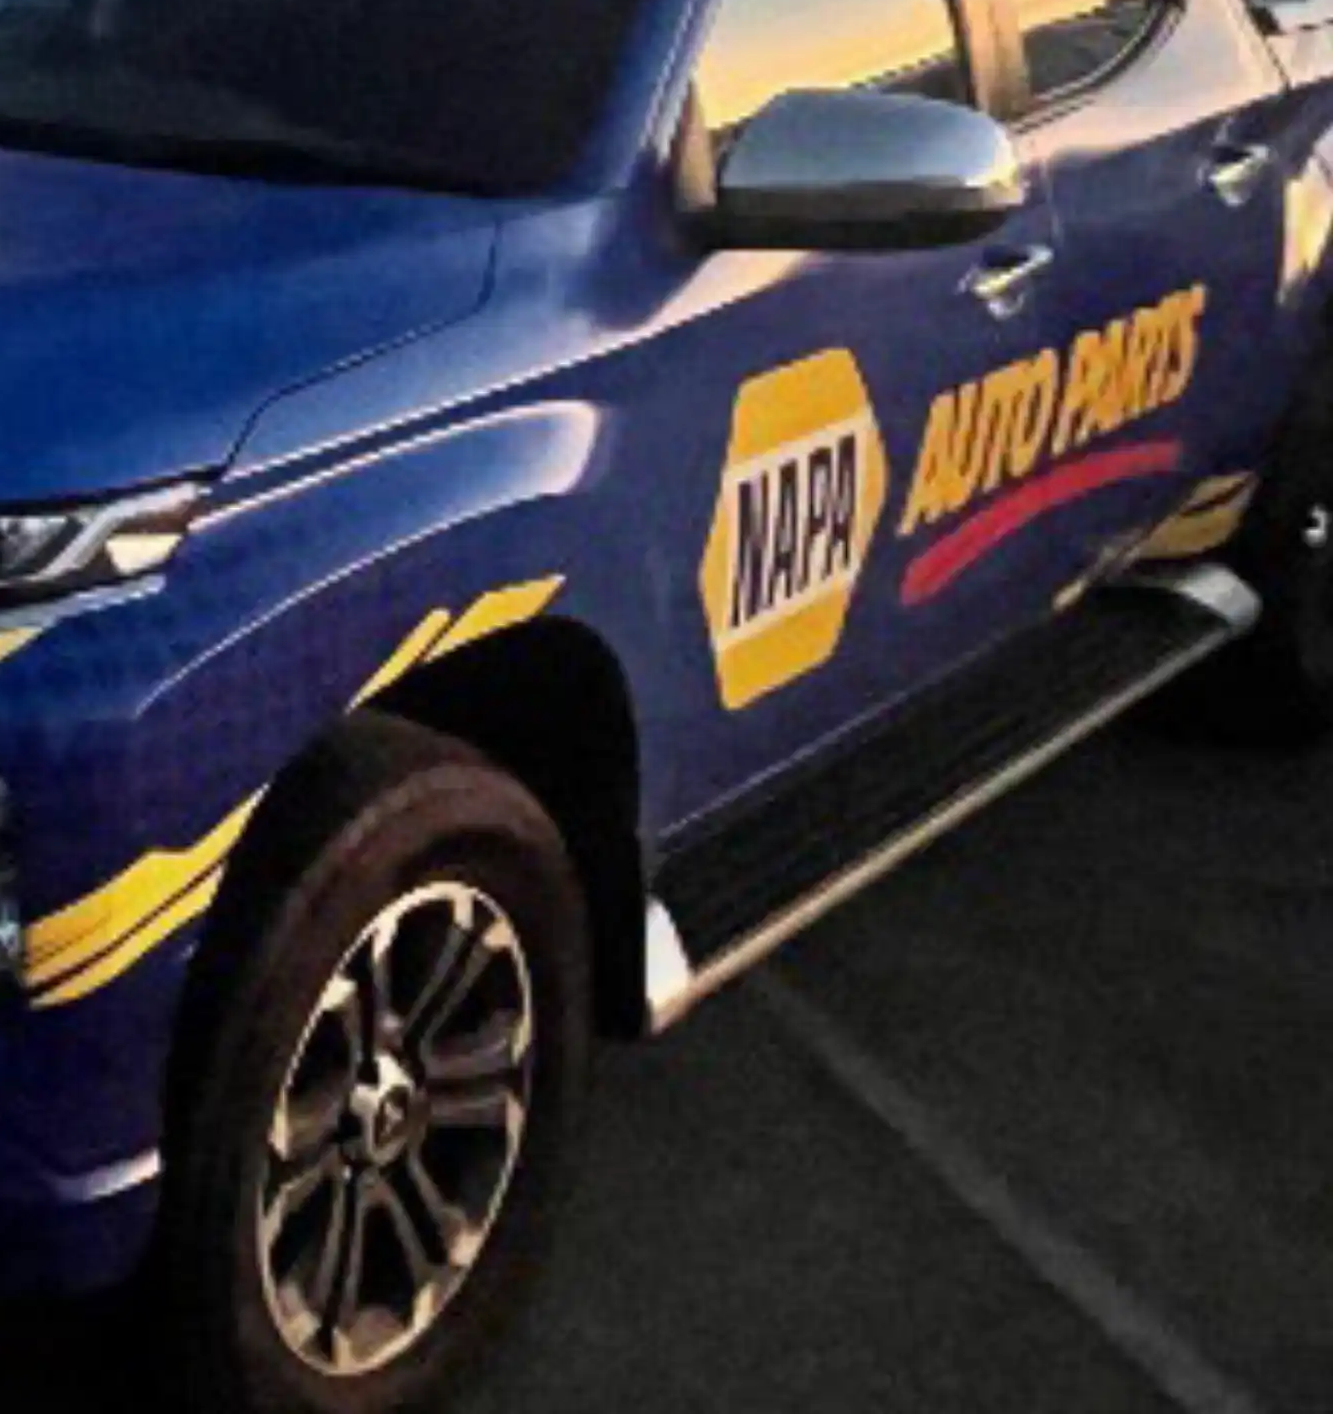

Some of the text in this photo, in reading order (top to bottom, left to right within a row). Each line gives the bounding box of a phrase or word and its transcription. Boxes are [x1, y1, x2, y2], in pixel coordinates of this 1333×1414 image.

[897, 284, 1207, 537] AUTO PARTS
[731, 433, 857, 628] NAPA
